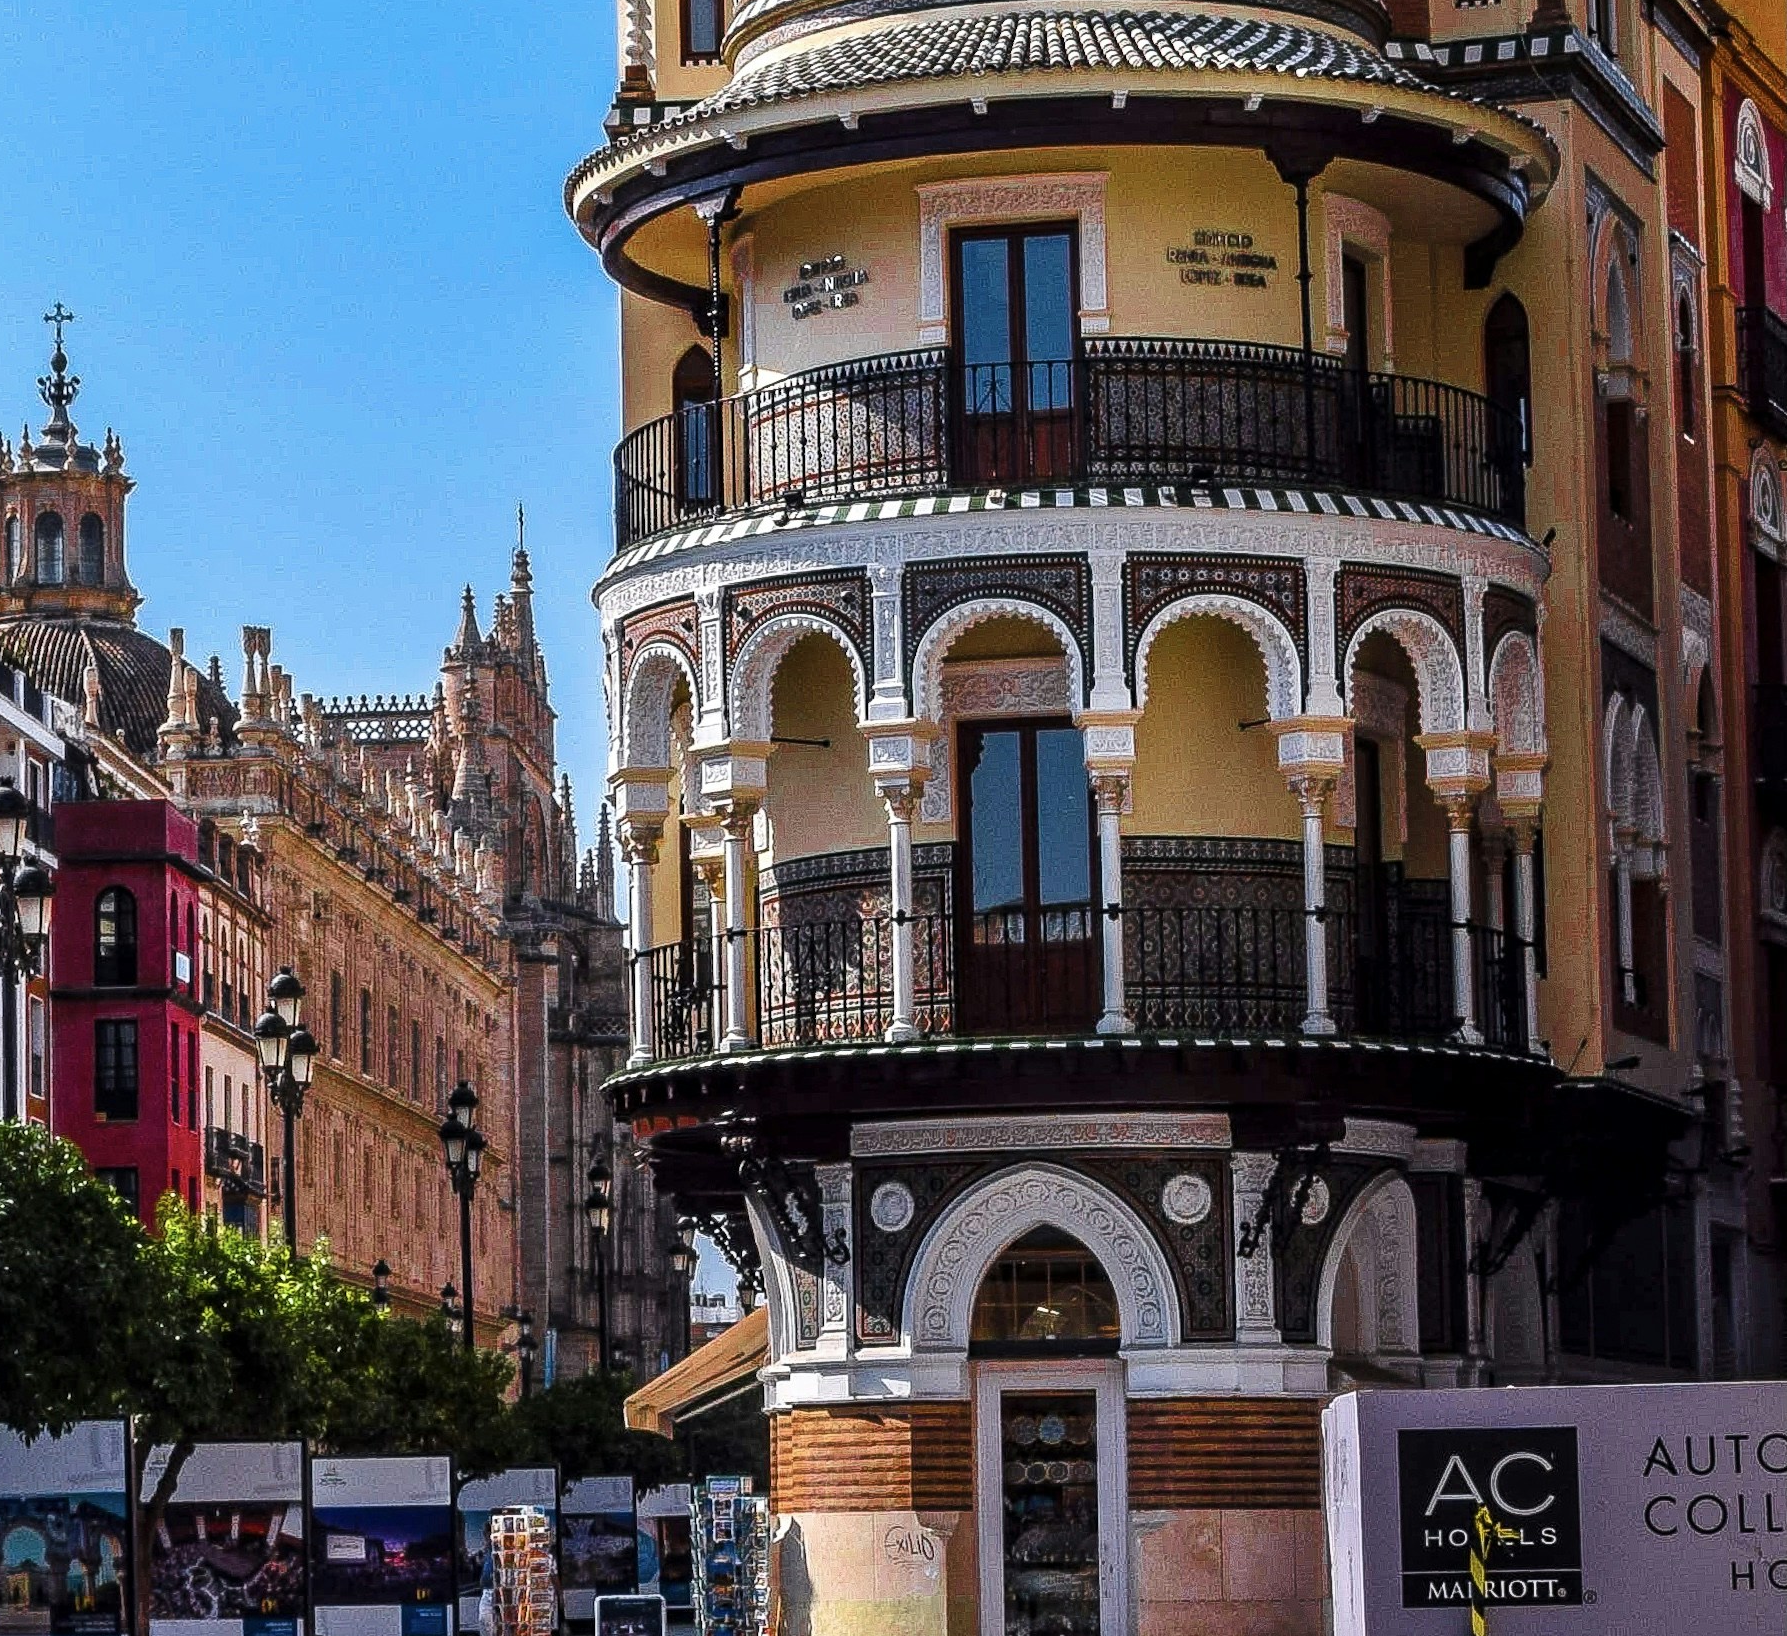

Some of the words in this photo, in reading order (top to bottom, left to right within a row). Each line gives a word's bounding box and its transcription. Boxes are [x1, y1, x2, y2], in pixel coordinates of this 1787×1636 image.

[1643, 1433, 1787, 1477] AUTO
[1424, 1451, 1555, 1516] AC
[1643, 1494, 1785, 1536] COLL
[1730, 1559, 1787, 1590] HO
